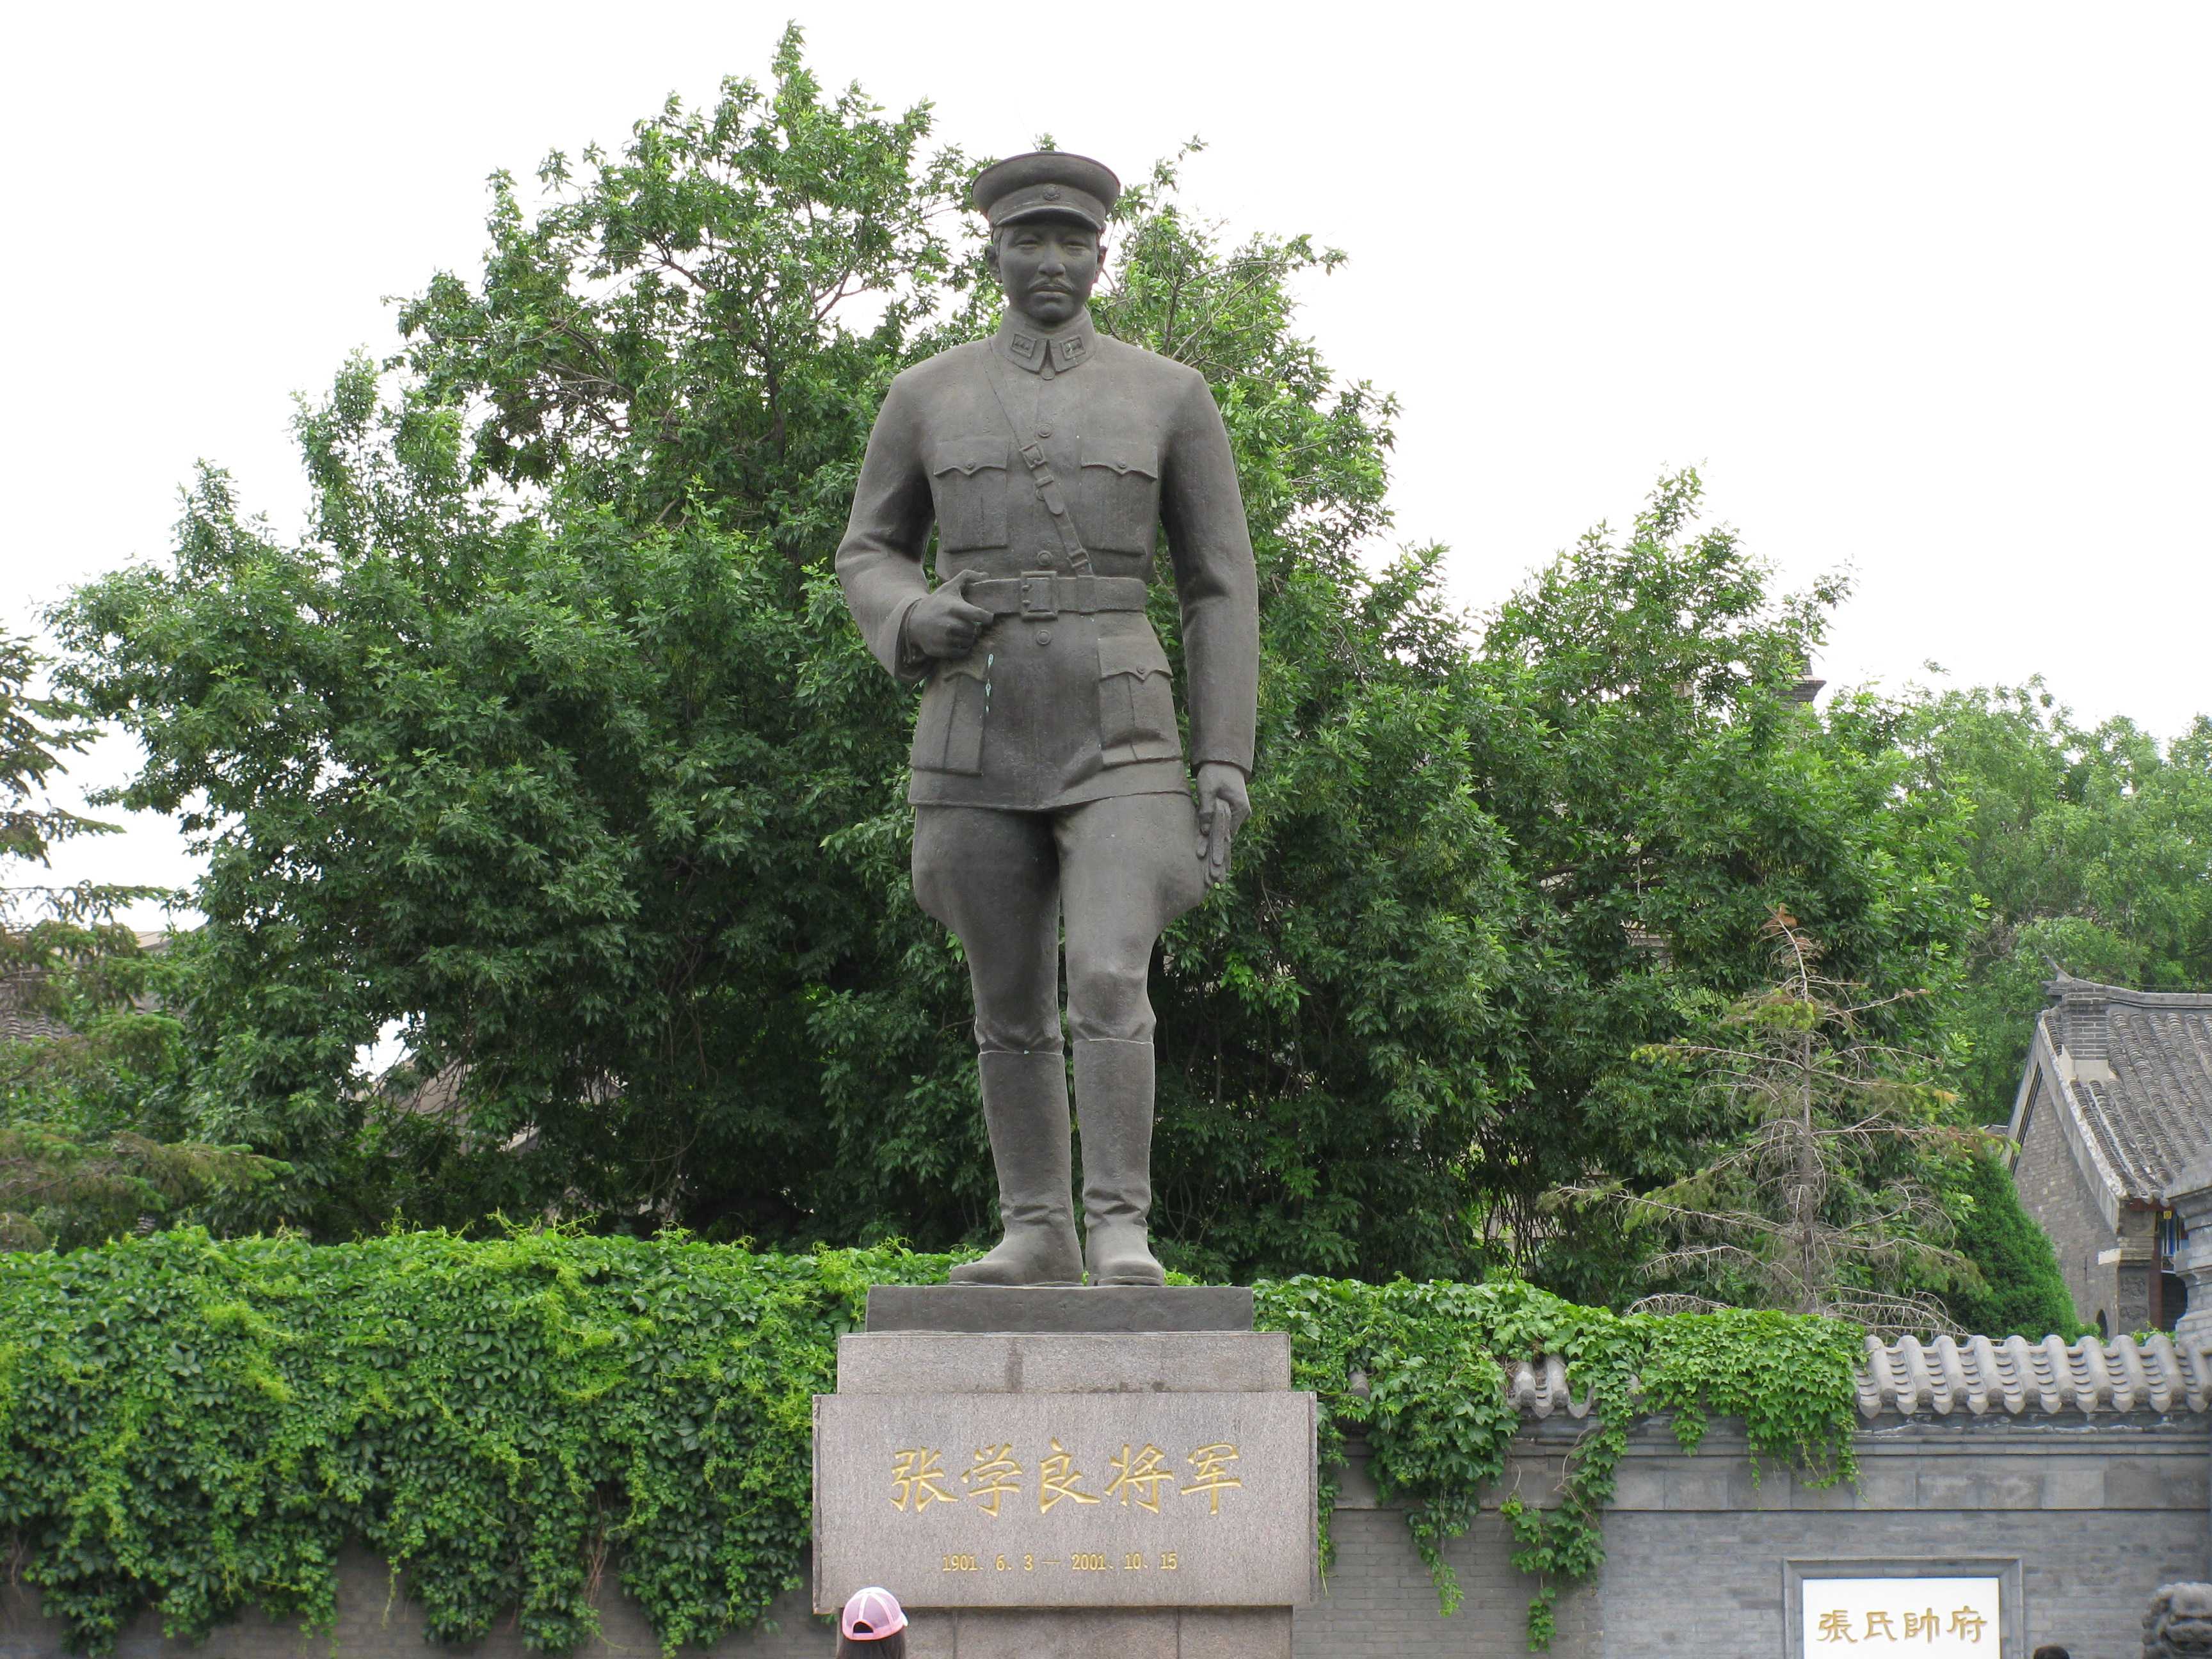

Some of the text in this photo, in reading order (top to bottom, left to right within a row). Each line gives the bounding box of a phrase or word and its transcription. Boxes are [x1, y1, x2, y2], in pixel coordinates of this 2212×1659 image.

[889, 1438, 1242, 1516] 张学良将军
[1160, 1552, 1178, 1569] 15
[1816, 1605, 1987, 1643] 張氏帥府
